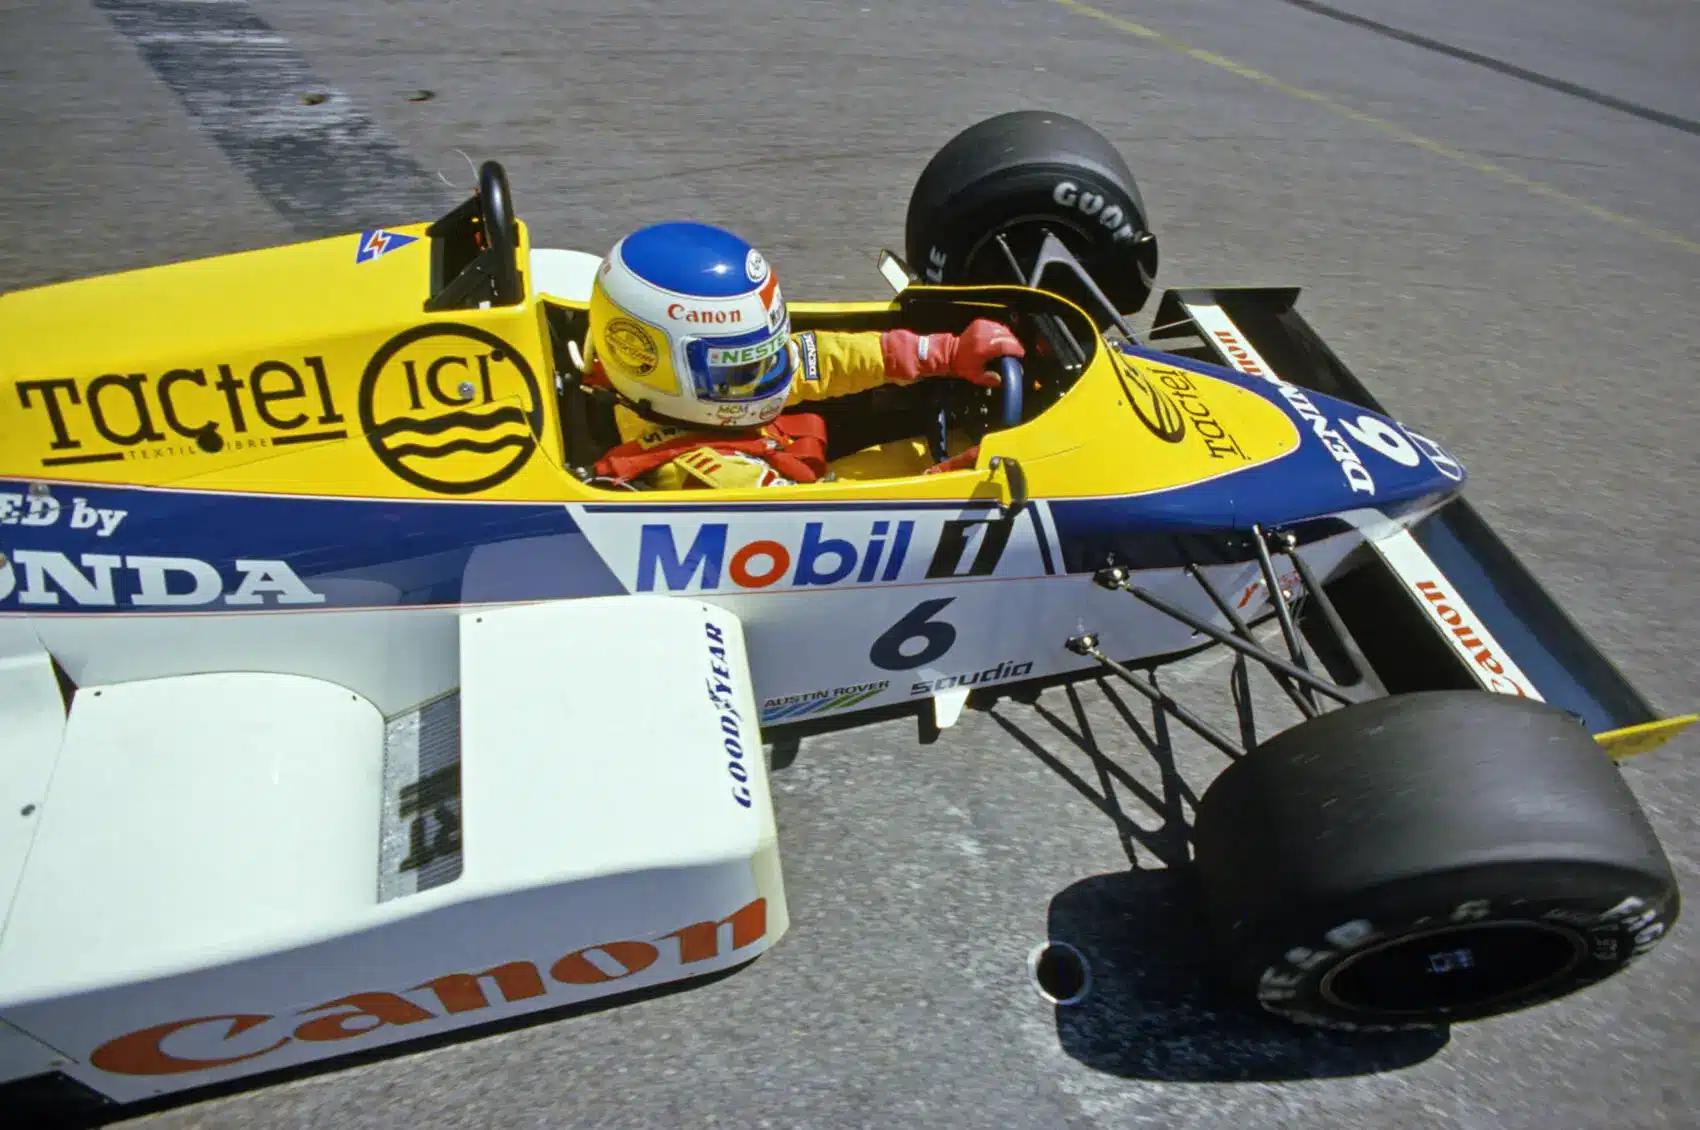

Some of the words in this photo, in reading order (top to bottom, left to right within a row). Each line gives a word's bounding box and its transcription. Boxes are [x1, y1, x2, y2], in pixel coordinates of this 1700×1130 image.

[667, 304, 742, 324] Canon
[16, 356, 345, 449] Tactel
[403, 353, 496, 411] ICI
[129, 445, 198, 459] TEXTIL
[225, 438, 268, 451] IBRE
[1338, 414, 1420, 468] 6
[69, 497, 128, 536] by
[0, 548, 325, 607] NDA
[636, 519, 916, 593] Mobil
[868, 596, 958, 671] 6
[763, 688, 829, 708] AUSTIN
[833, 680, 891, 697] ROVER
[910, 660, 1034, 697] saudia
[704, 622, 752, 809] GOODYEAR
[89, 897, 768, 1075] Canon
